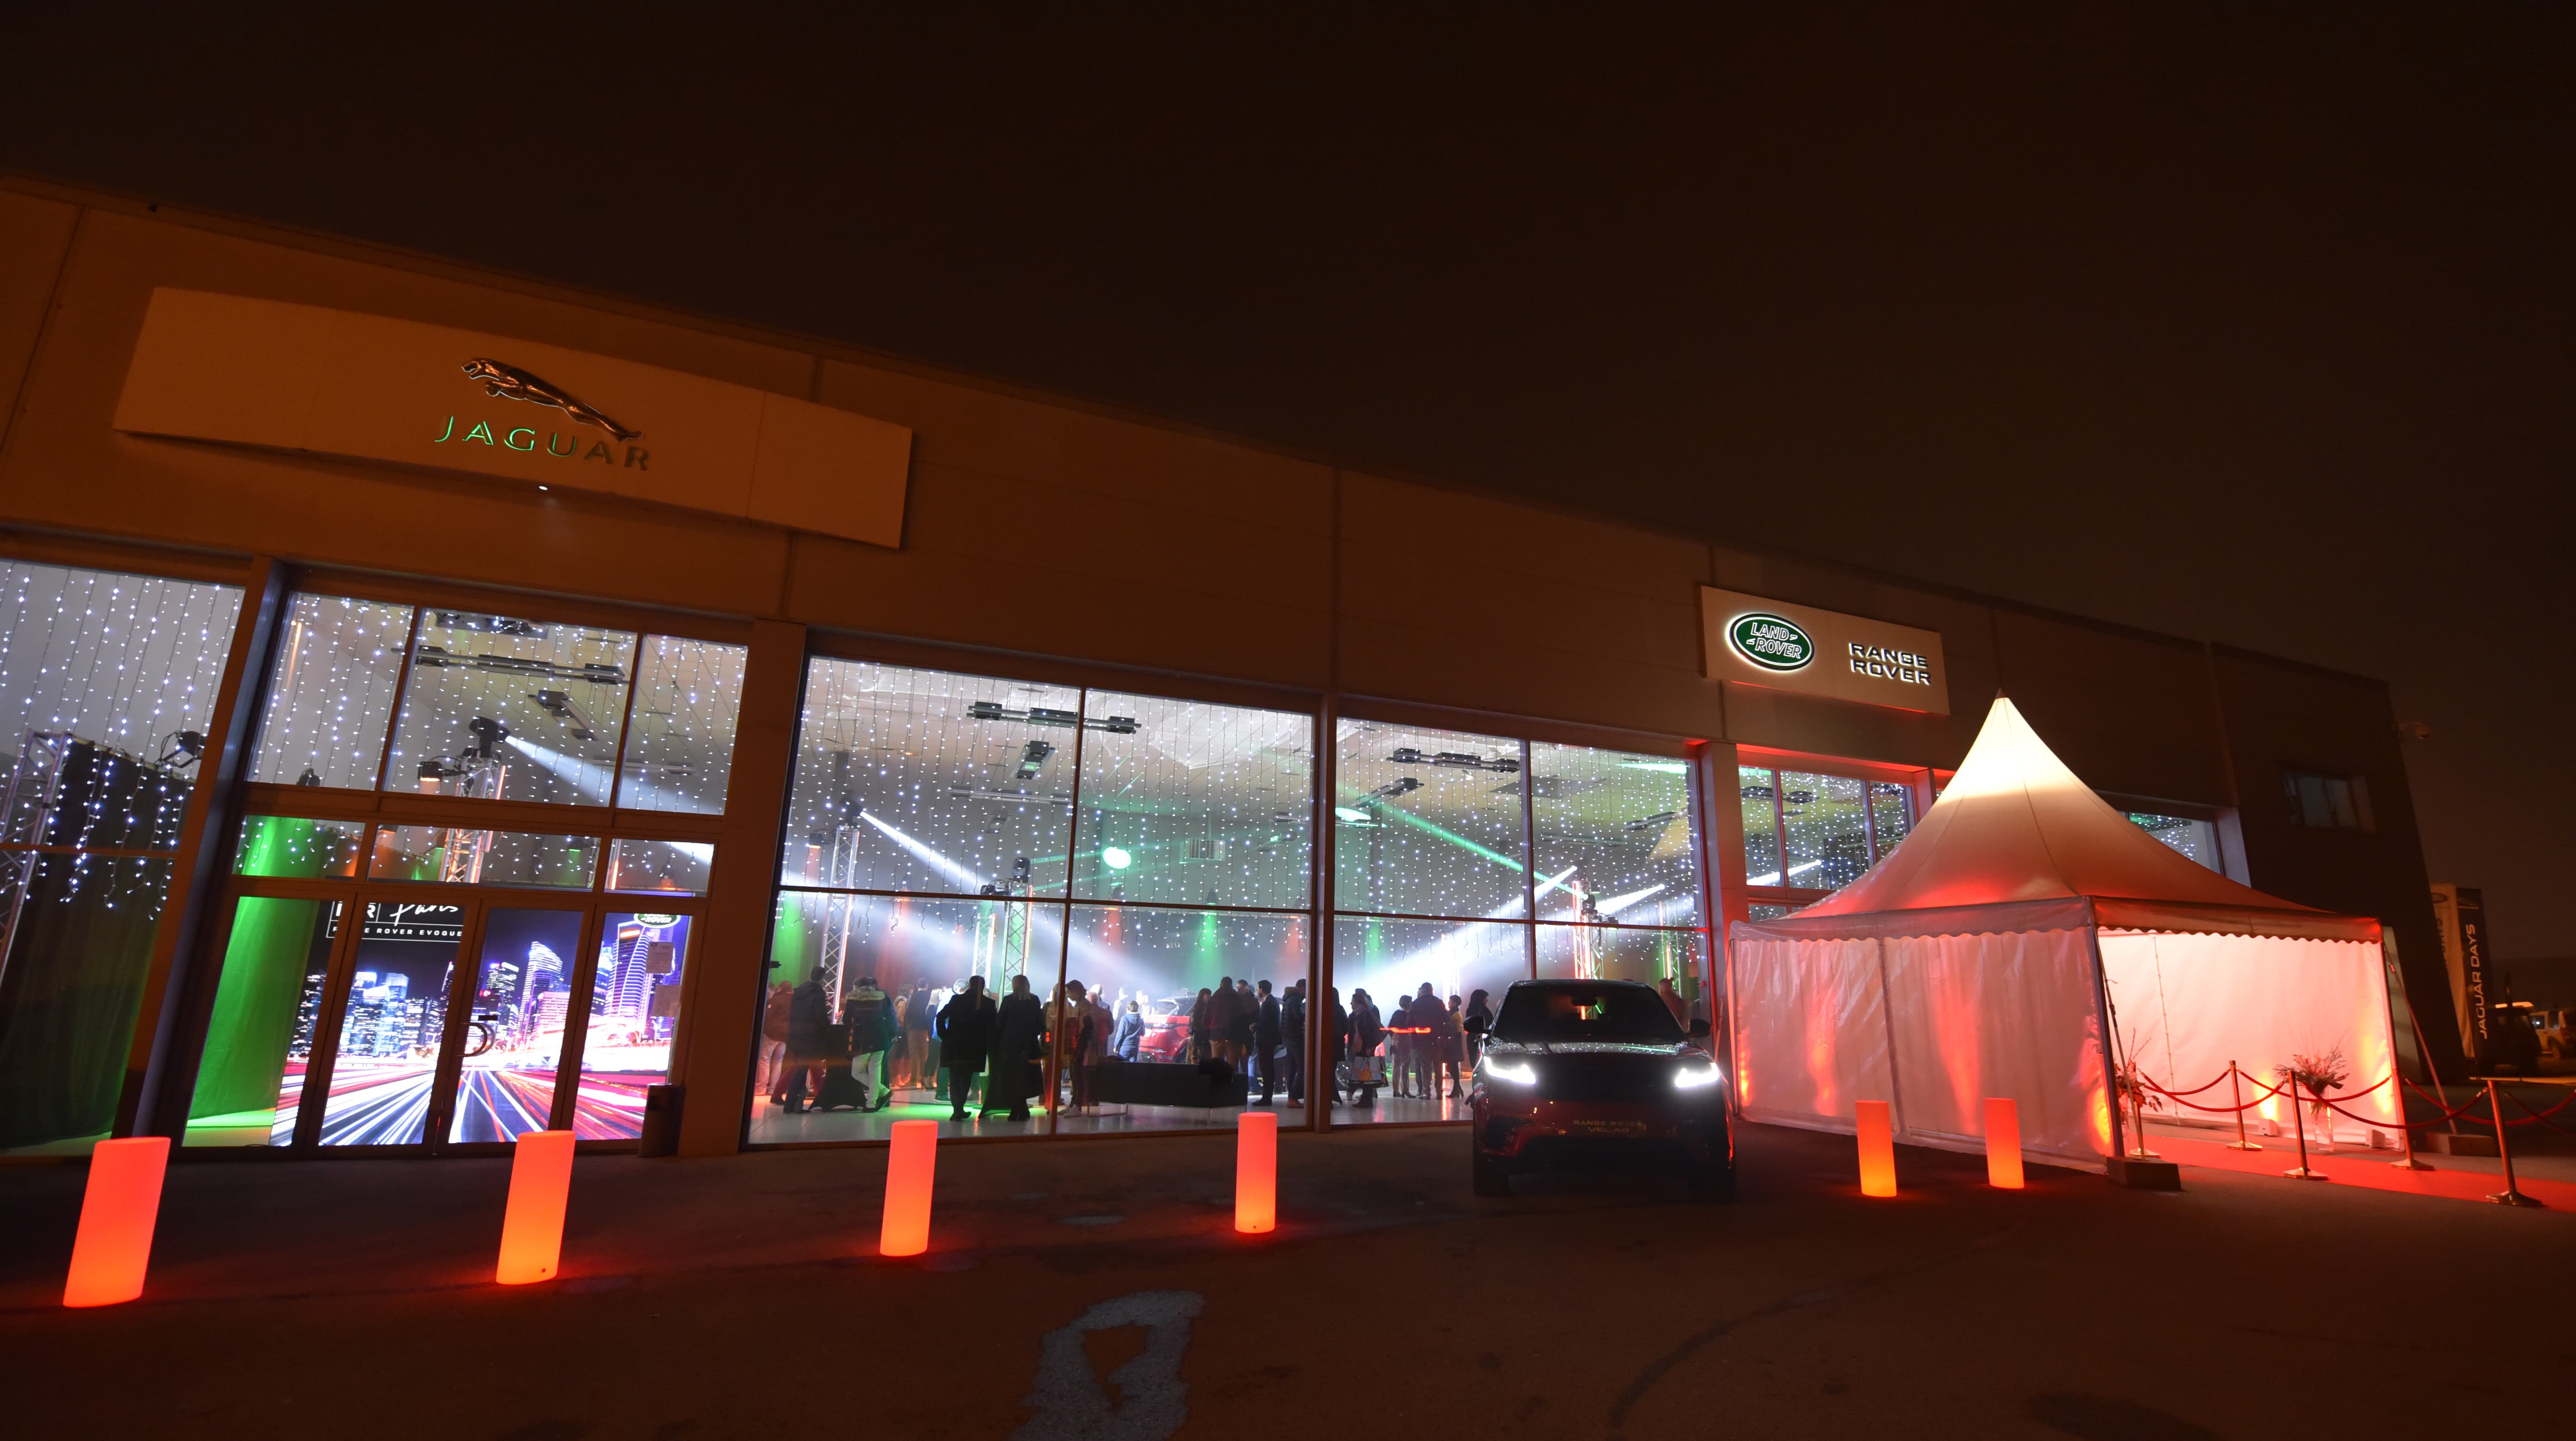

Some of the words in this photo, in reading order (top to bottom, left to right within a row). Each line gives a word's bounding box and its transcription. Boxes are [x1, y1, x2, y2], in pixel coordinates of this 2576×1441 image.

[435, 415, 649, 471] JAGUAR
[1751, 622, 1789, 641] LAND
[1755, 638, 1802, 659] ROVER
[1849, 642, 1928, 668] RANGE
[1851, 659, 1931, 685] ROVER
[2466, 924, 2481, 967] DAYS
[2471, 971, 2487, 1040] JAGUAR
